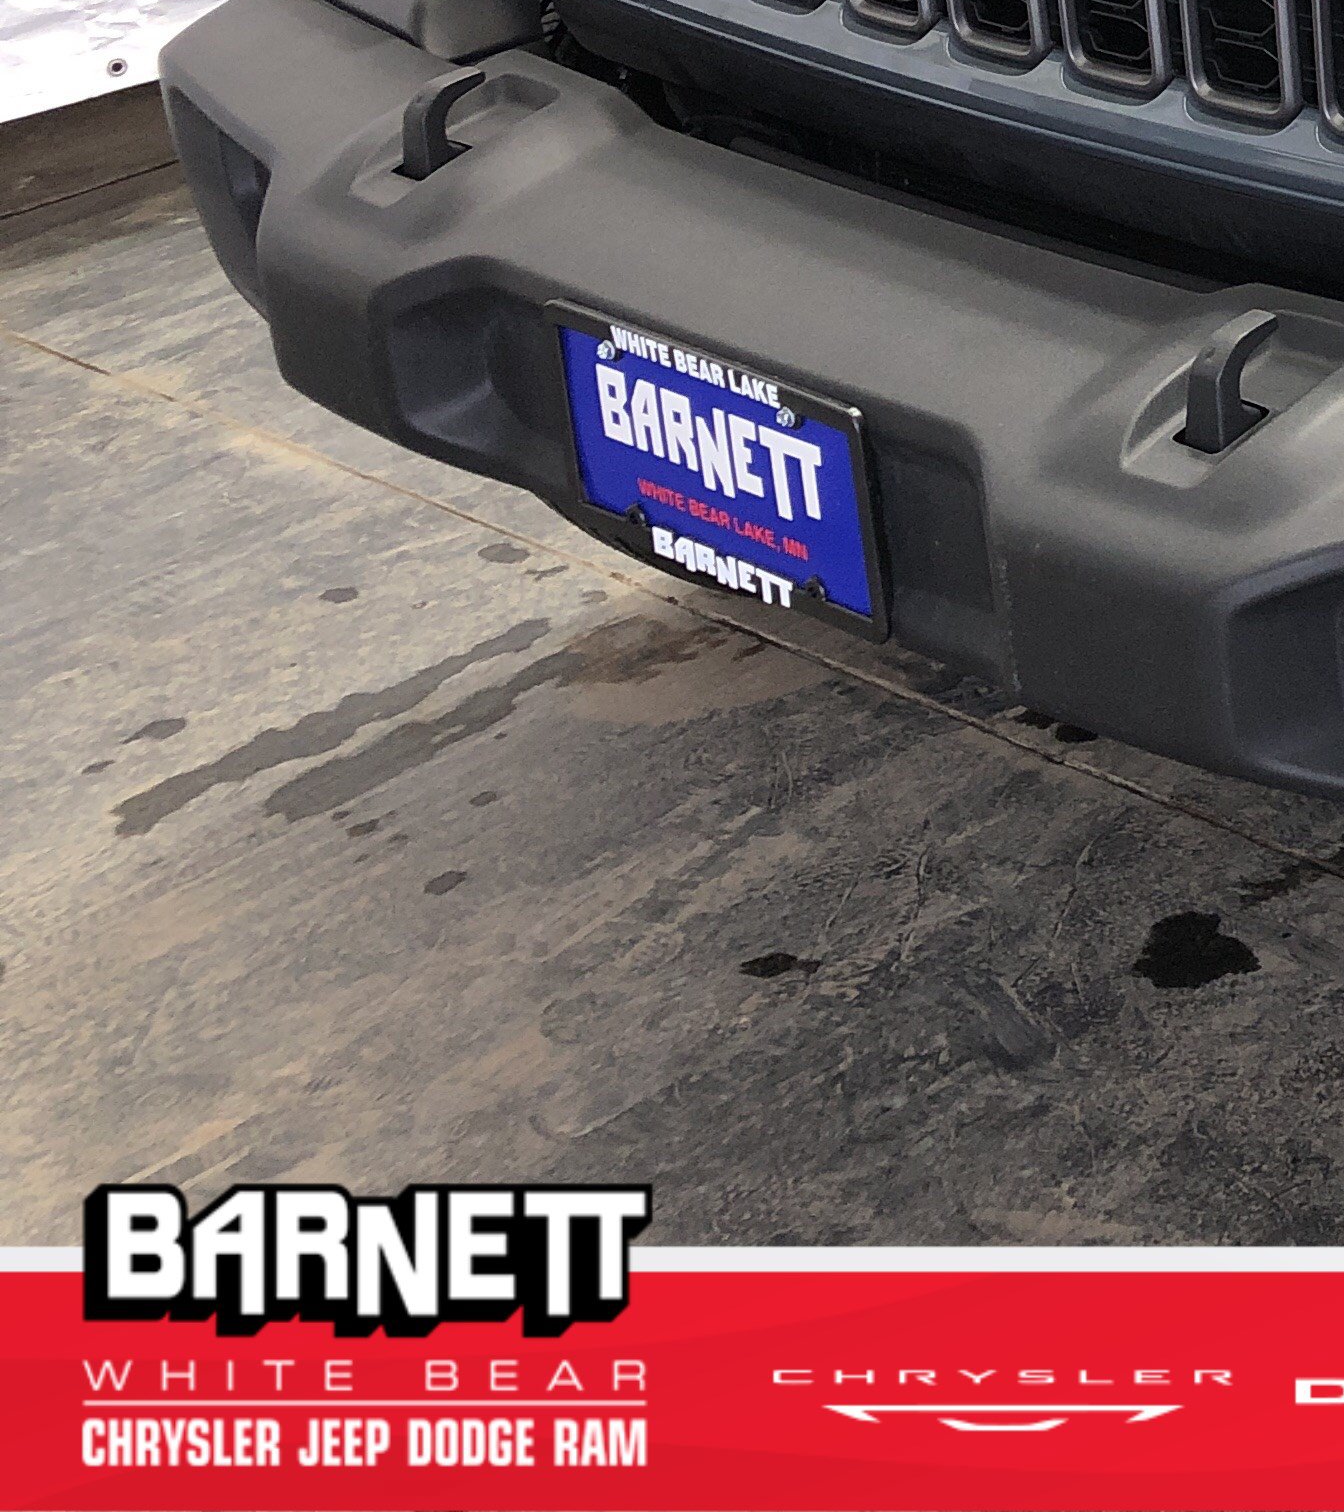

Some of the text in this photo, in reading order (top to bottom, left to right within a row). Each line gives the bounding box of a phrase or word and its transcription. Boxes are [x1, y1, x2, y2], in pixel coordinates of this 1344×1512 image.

[609, 325, 781, 409] WHITE BEAR LAKE
[595, 362, 822, 522] BARNETT
[636, 476, 810, 563] WHITE BEAR LAKE, MN
[651, 525, 794, 609] BARNETT
